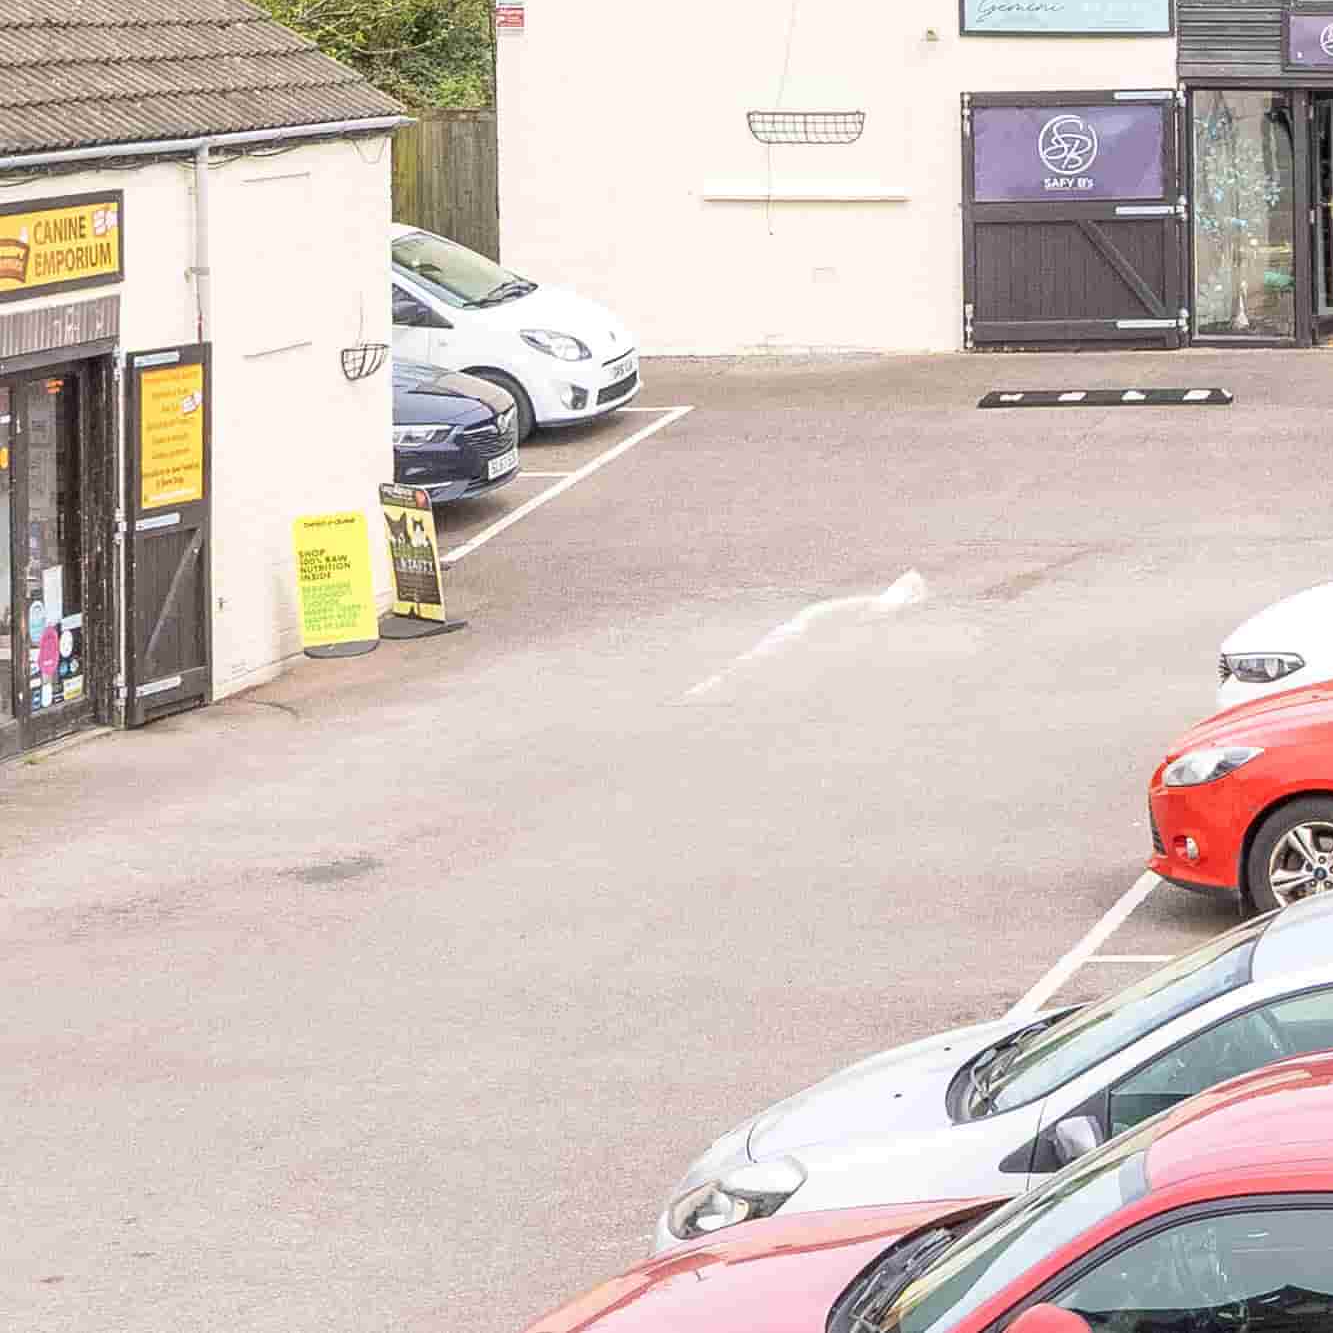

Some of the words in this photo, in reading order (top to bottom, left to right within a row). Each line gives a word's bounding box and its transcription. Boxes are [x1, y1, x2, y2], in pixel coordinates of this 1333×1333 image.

[1044, 178, 1074, 188] SAFY
[33, 216, 86, 245] CANINE
[34, 242, 112, 277] EMPORIUM
[298, 548, 325, 557] SHOP
[325, 555, 348, 563] RAW
[300, 562, 351, 573] NUTRITION
[301, 571, 331, 580] INSIDE
